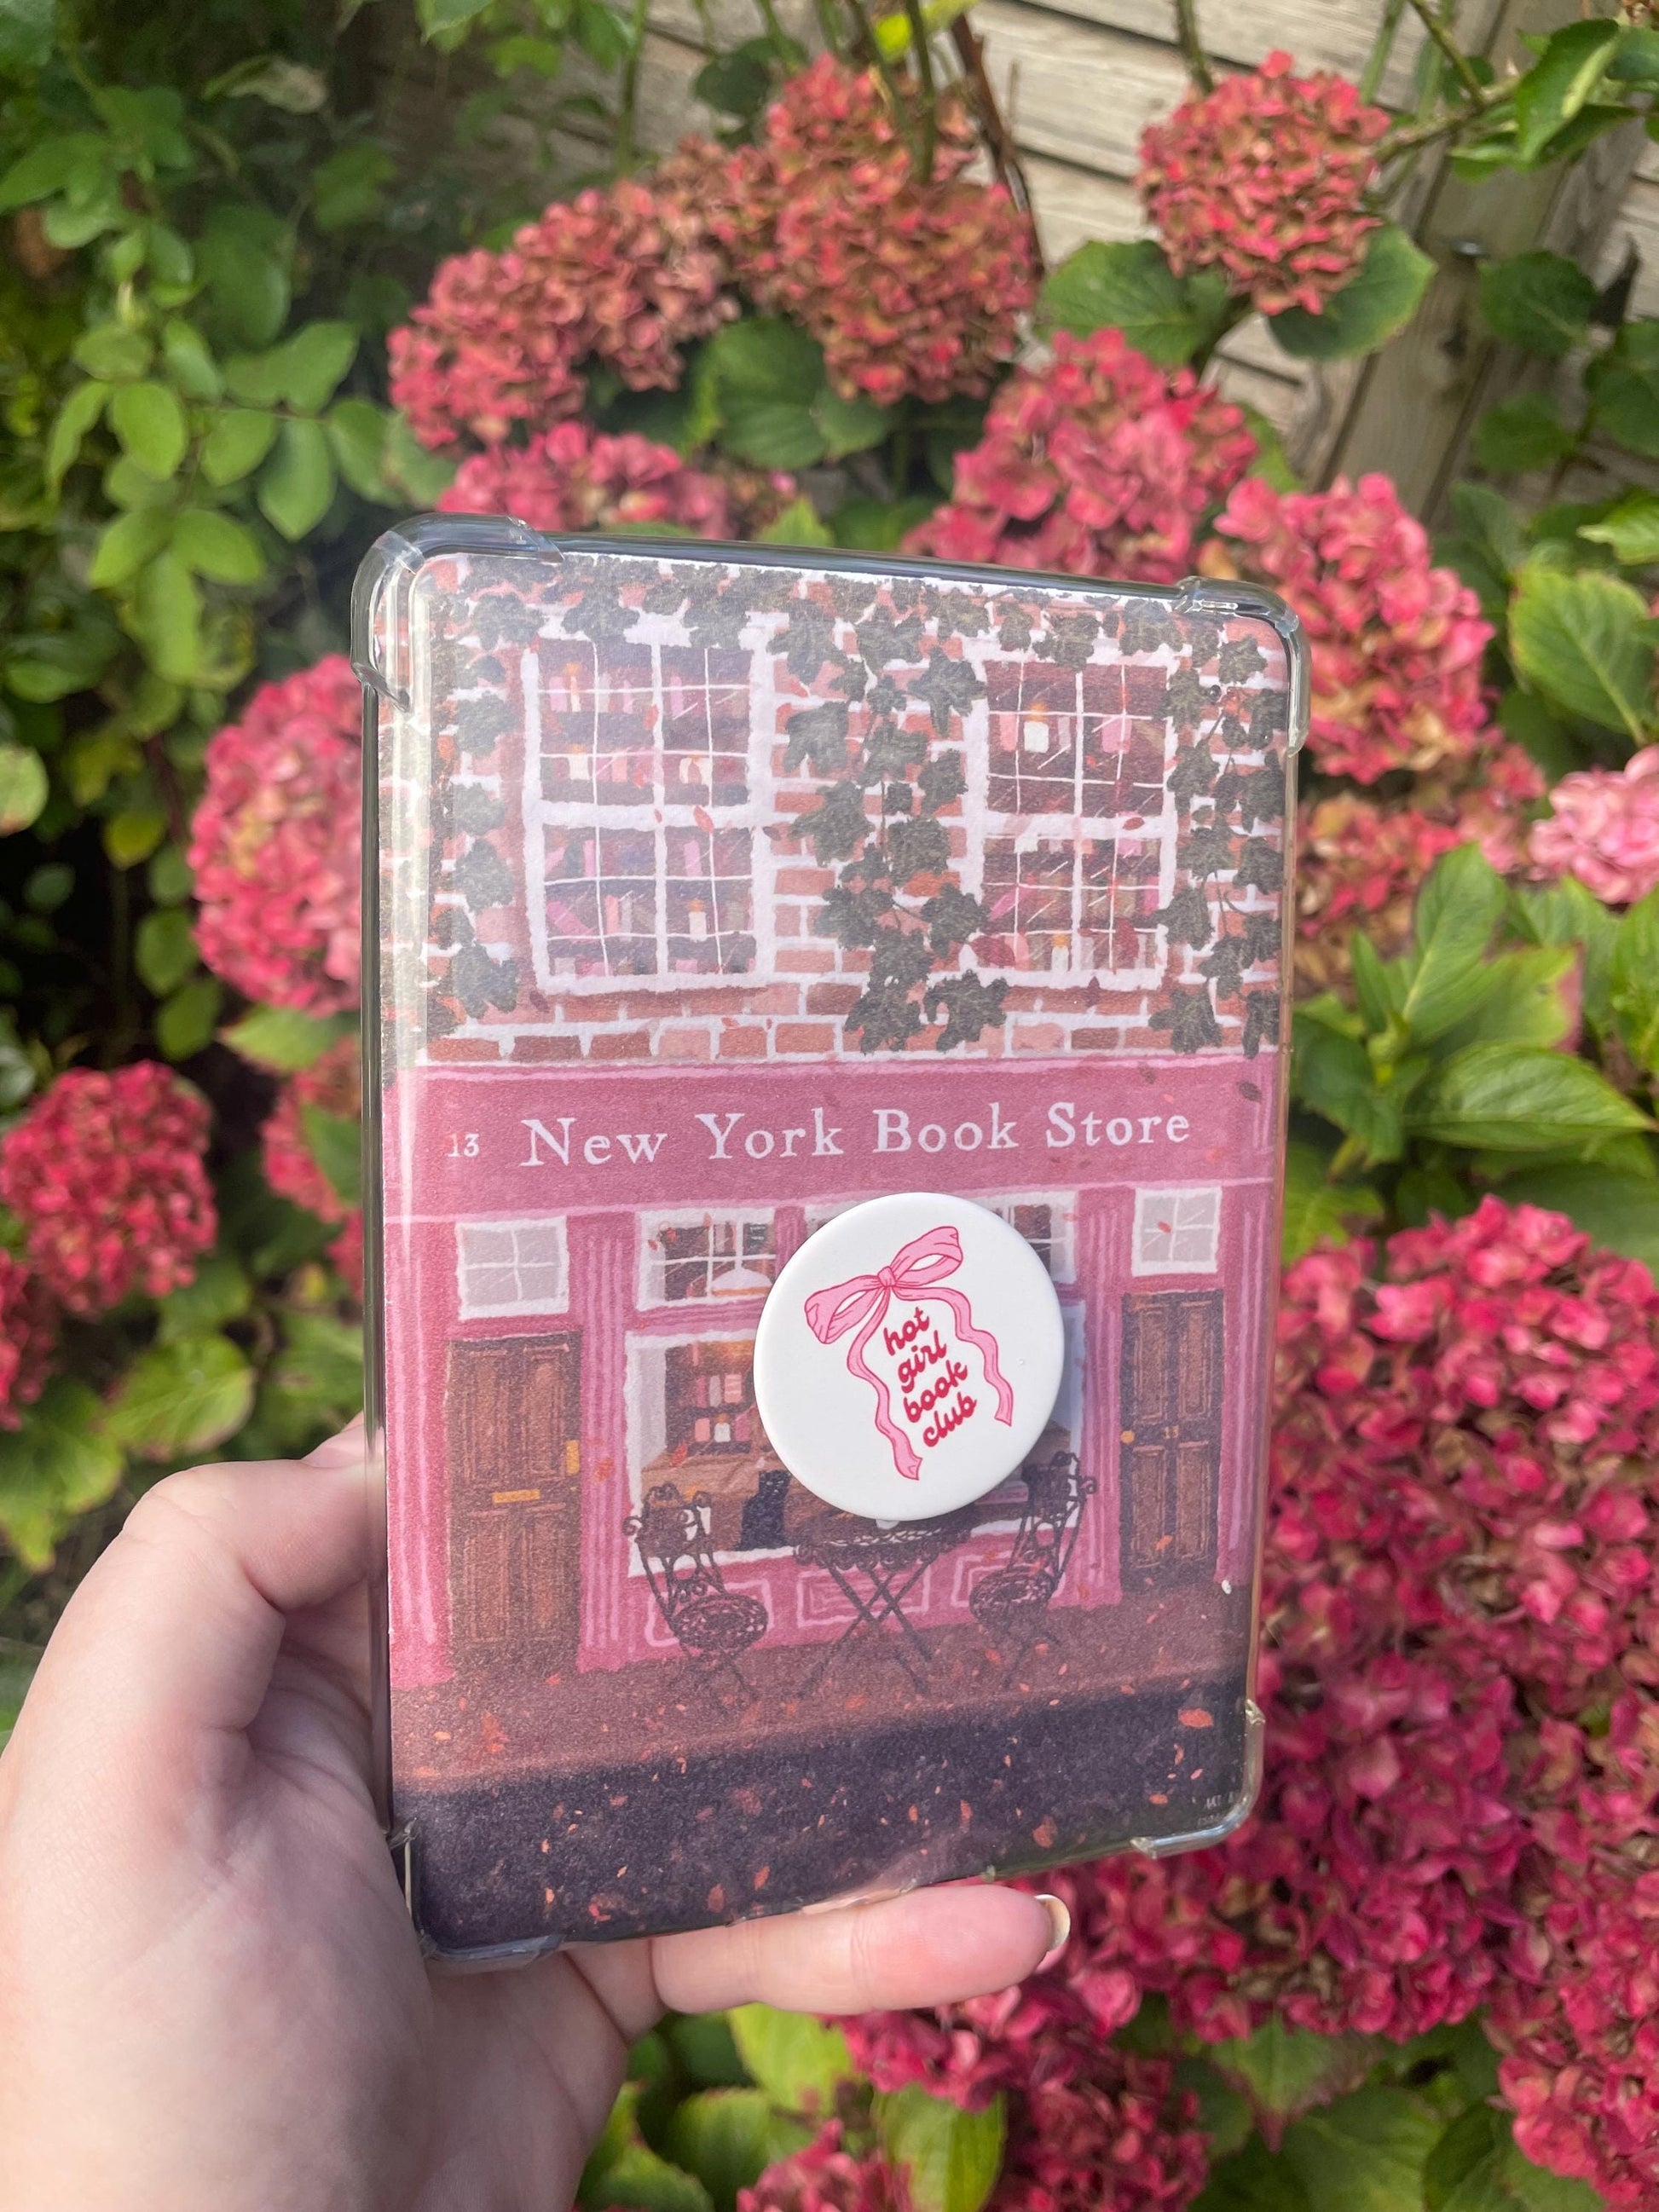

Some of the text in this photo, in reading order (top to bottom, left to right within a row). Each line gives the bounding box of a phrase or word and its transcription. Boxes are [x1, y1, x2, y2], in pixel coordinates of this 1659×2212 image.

[448, 1101, 1190, 1167] 13 New York Book Store
[884, 1307, 929, 1355] hot
[898, 1330, 947, 1393] girl
[903, 1360, 968, 1423] book
[923, 1392, 978, 1447] club
